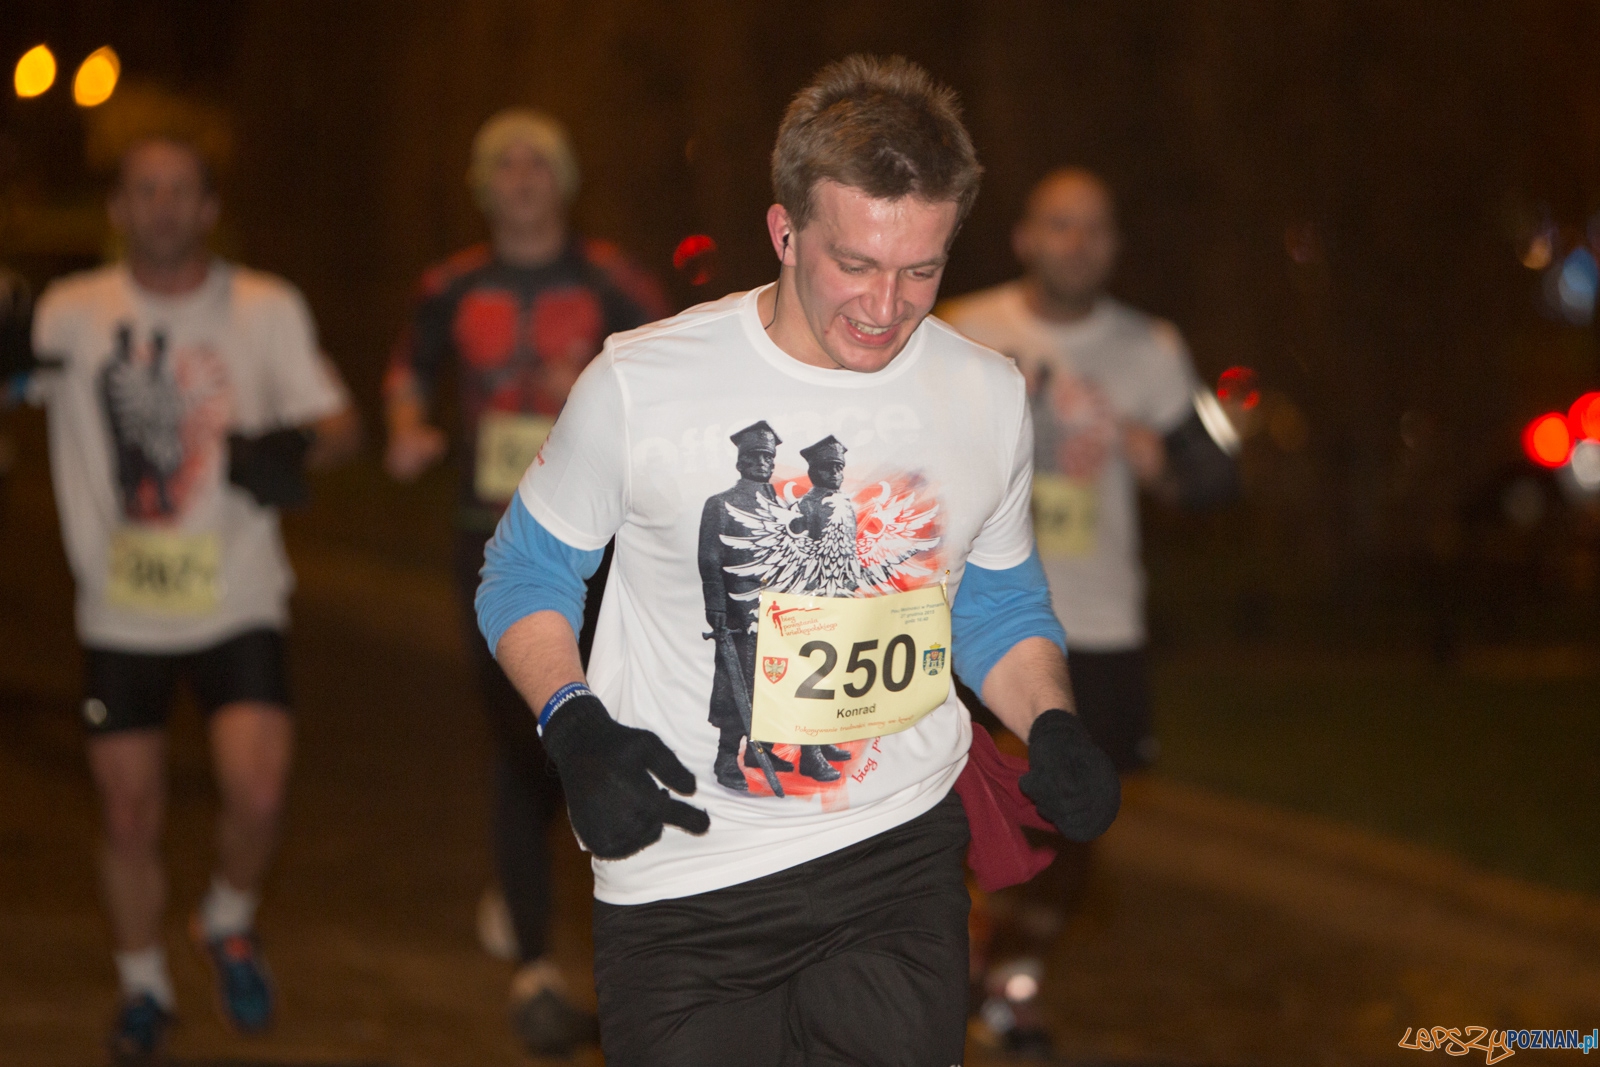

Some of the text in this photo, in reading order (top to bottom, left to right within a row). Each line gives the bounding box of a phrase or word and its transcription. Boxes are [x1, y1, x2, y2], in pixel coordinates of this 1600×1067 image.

[780, 615, 796, 624] bieg
[782, 617, 819, 631] powstania
[785, 622, 838, 636] wielkopolskiego
[794, 633, 916, 700] 250
[836, 703, 876, 719] Konrad
[851, 757, 878, 783] bieg
